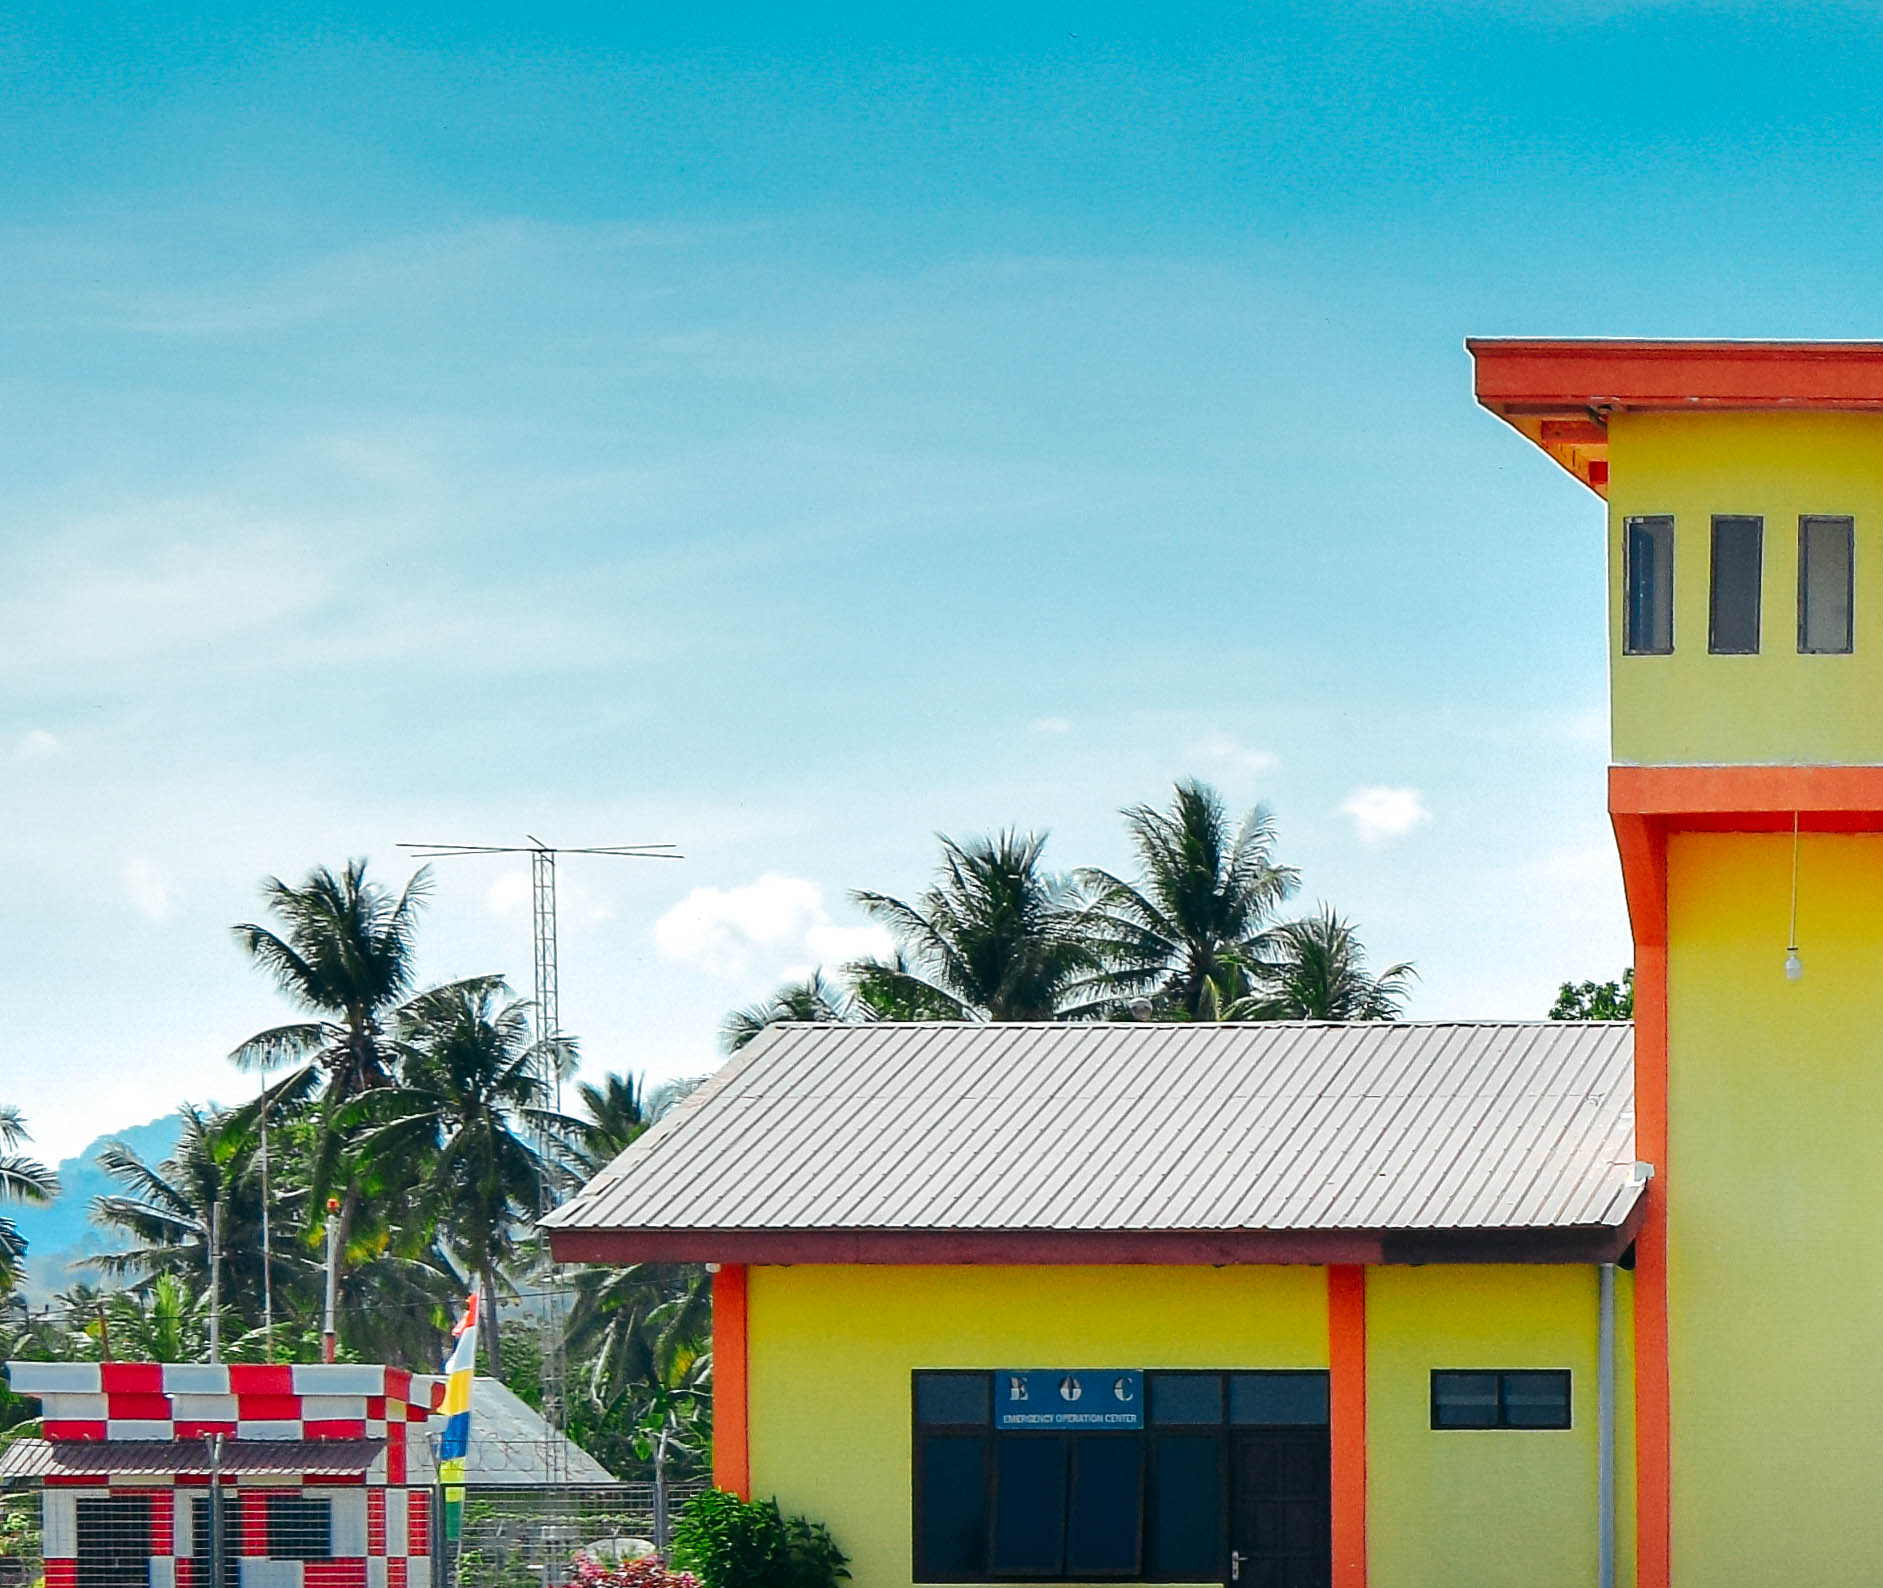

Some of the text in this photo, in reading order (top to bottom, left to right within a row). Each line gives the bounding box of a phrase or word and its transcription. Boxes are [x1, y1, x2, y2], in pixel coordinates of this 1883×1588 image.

[1003, 1413, 1137, 1423] EMERGENCY OPERATION CENTER
